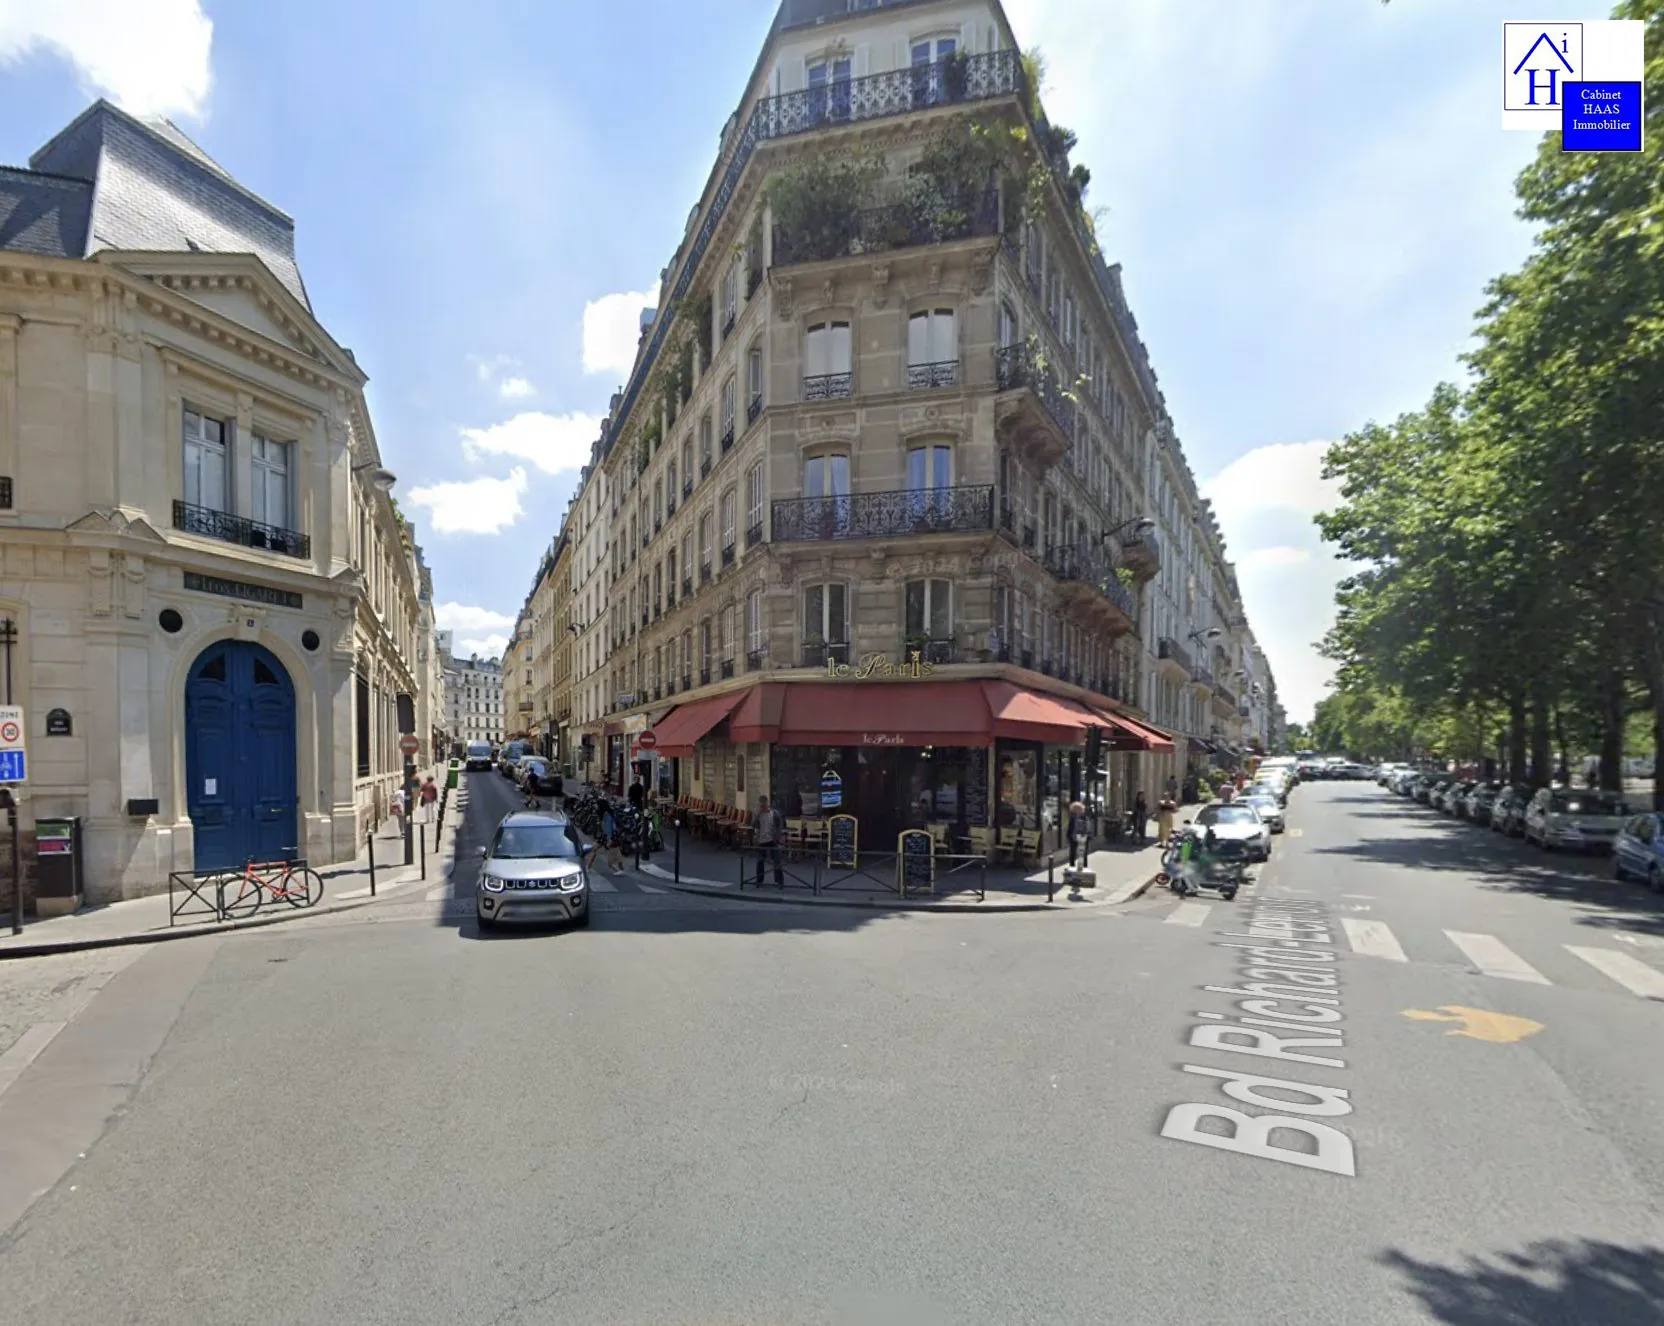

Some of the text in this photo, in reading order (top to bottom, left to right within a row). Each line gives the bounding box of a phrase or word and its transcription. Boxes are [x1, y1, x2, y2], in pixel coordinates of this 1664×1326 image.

[827, 650, 936, 679] le Paris
[872, 733, 904, 744] Paris
